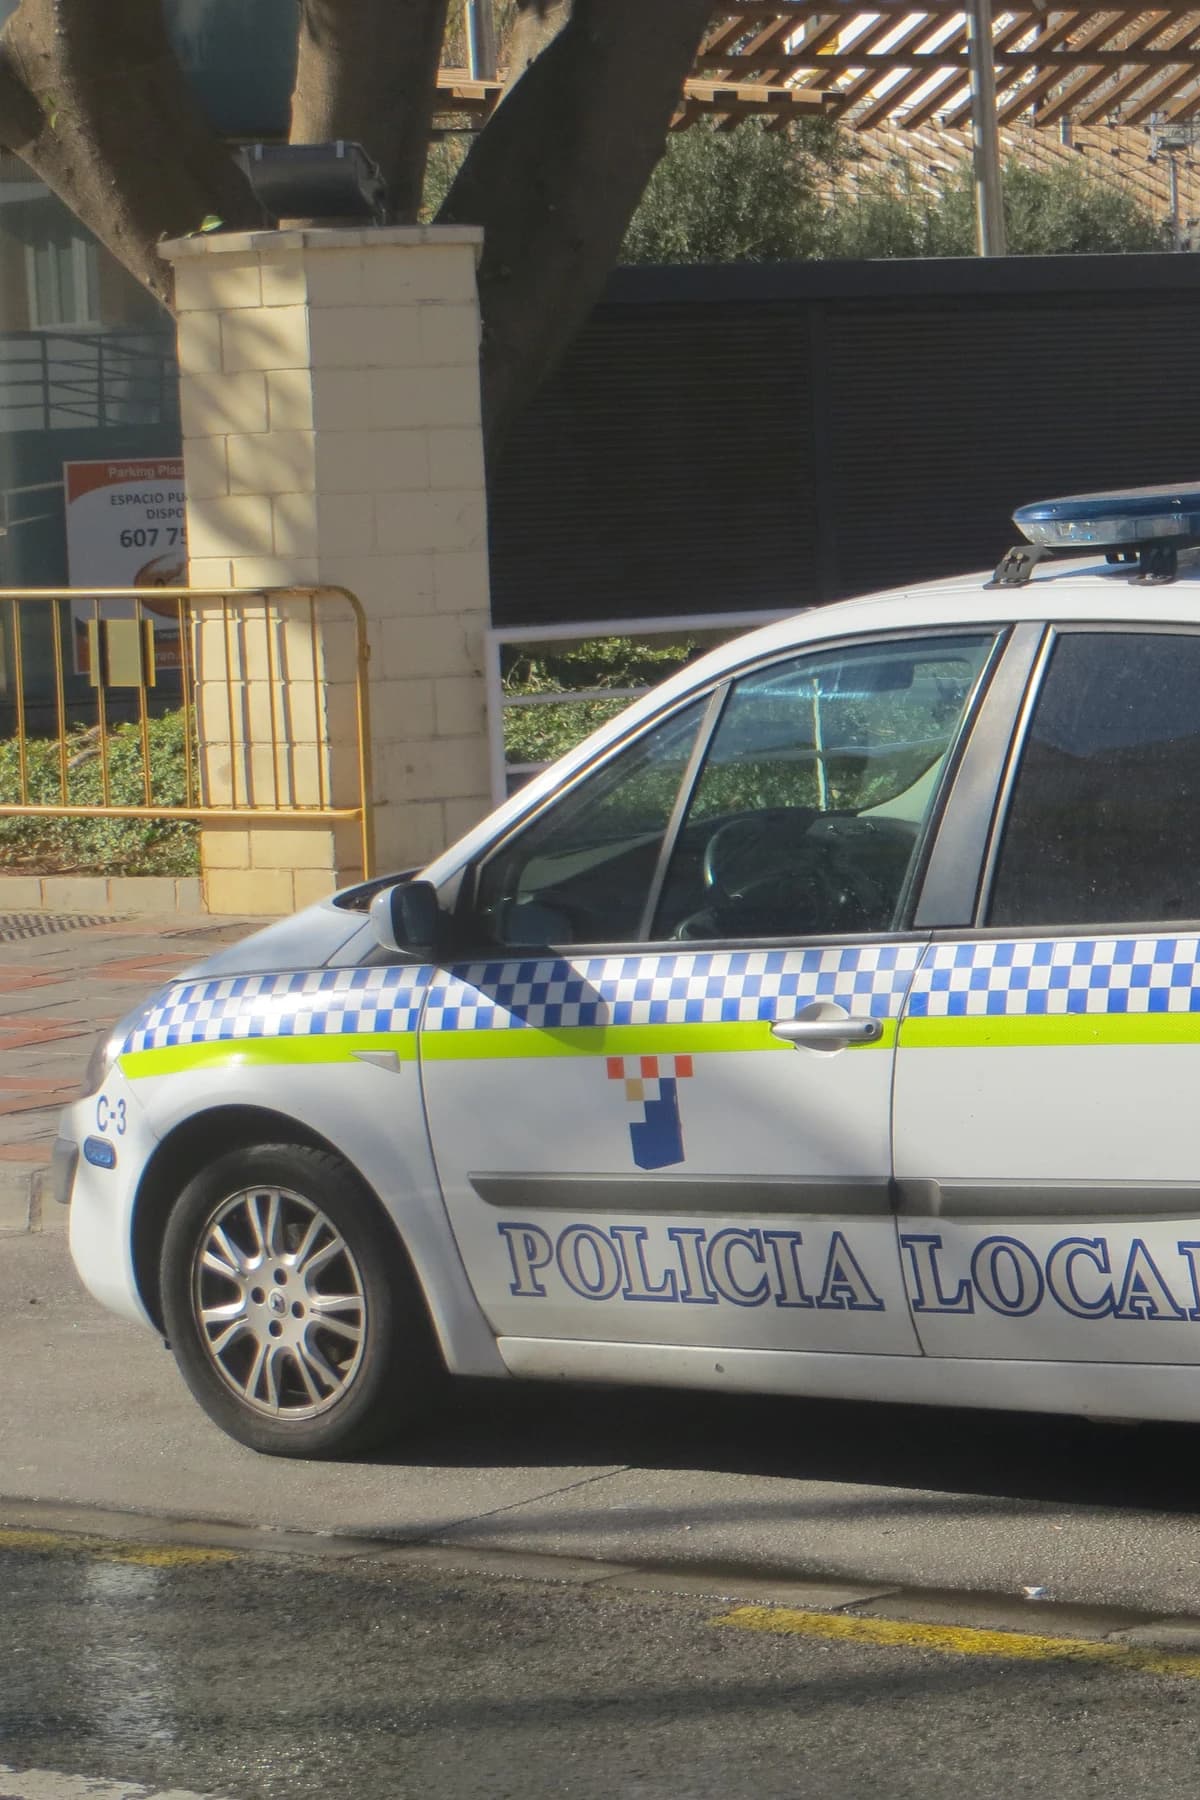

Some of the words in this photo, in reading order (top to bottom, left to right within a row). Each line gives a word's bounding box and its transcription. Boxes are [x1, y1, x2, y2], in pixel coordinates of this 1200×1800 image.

[108, 465, 155, 480] Parking
[111, 492, 164, 506] ESPACIO
[120, 528, 159, 548] 607
[96, 1094, 127, 1136] C-3
[497, 1221, 887, 1312] POLICIA
